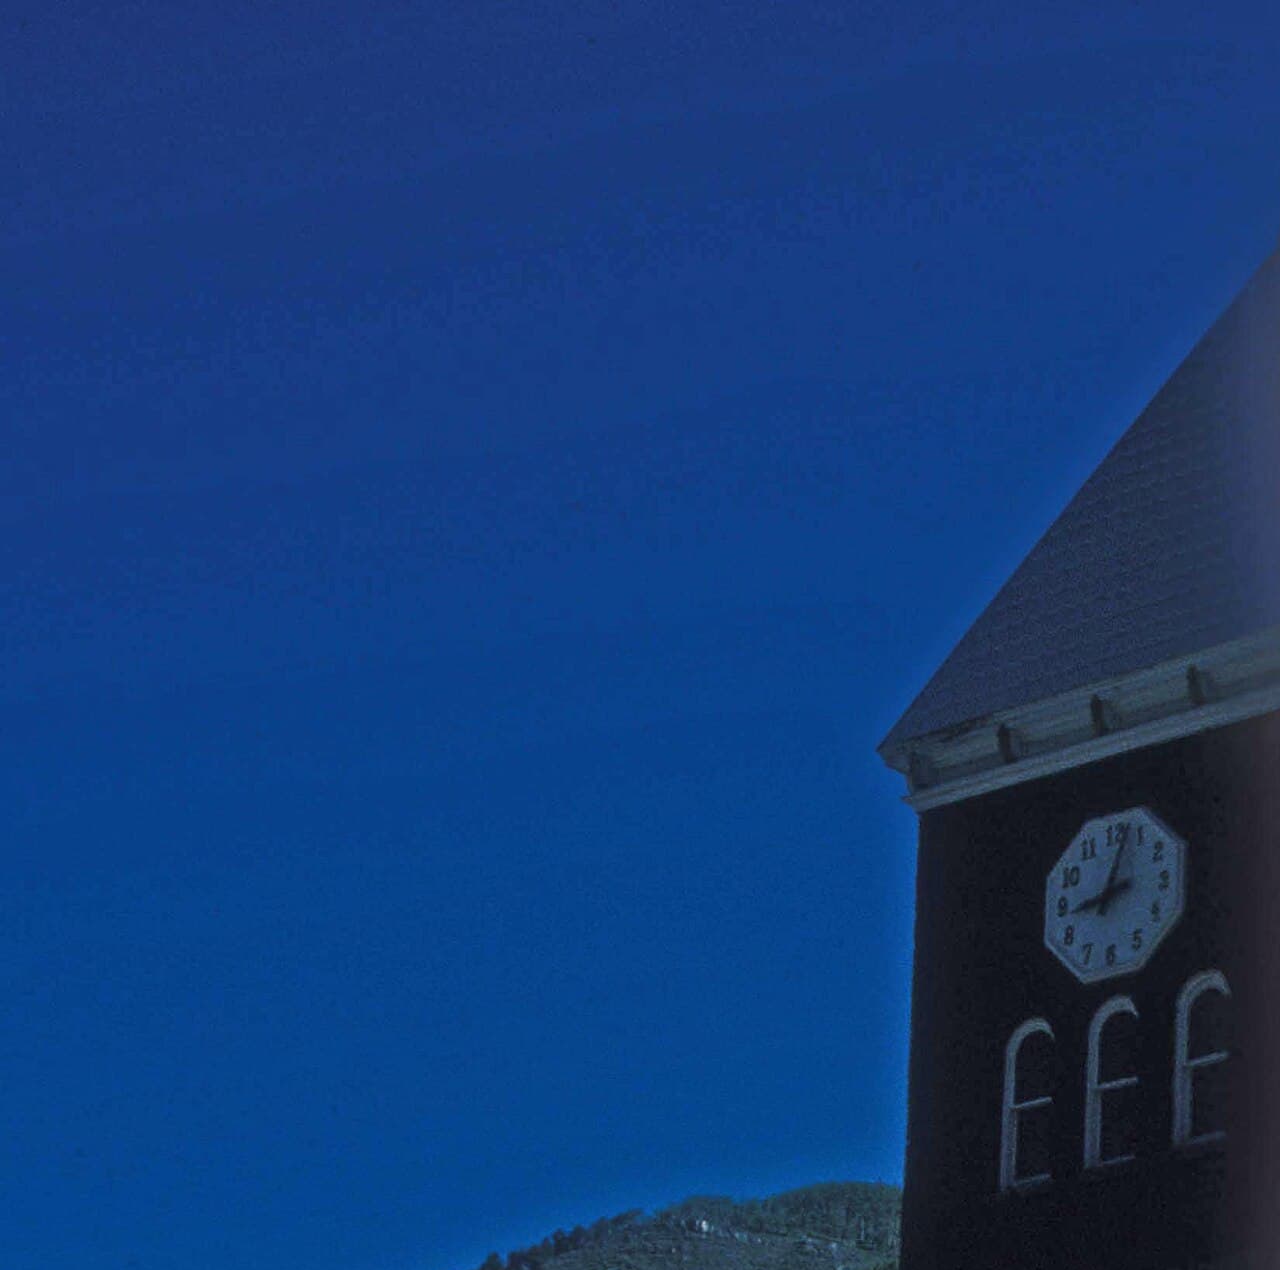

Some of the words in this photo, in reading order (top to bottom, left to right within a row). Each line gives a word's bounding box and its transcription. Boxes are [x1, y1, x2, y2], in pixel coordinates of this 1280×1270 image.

[1106, 822, 1130, 847] 12
[1136, 825, 1144, 846] 1
[1080, 838, 1096, 861] 11
[1152, 841, 1164, 861] 2
[1063, 867, 1080, 889] 10
[1158, 870, 1170, 890] 3
[1056, 897, 1067, 917] 9
[1065, 925, 1075, 945] 8
[1132, 929, 1143, 951] 5
[1083, 943, 1093, 965] 7
[1105, 944, 1116, 967] 6
